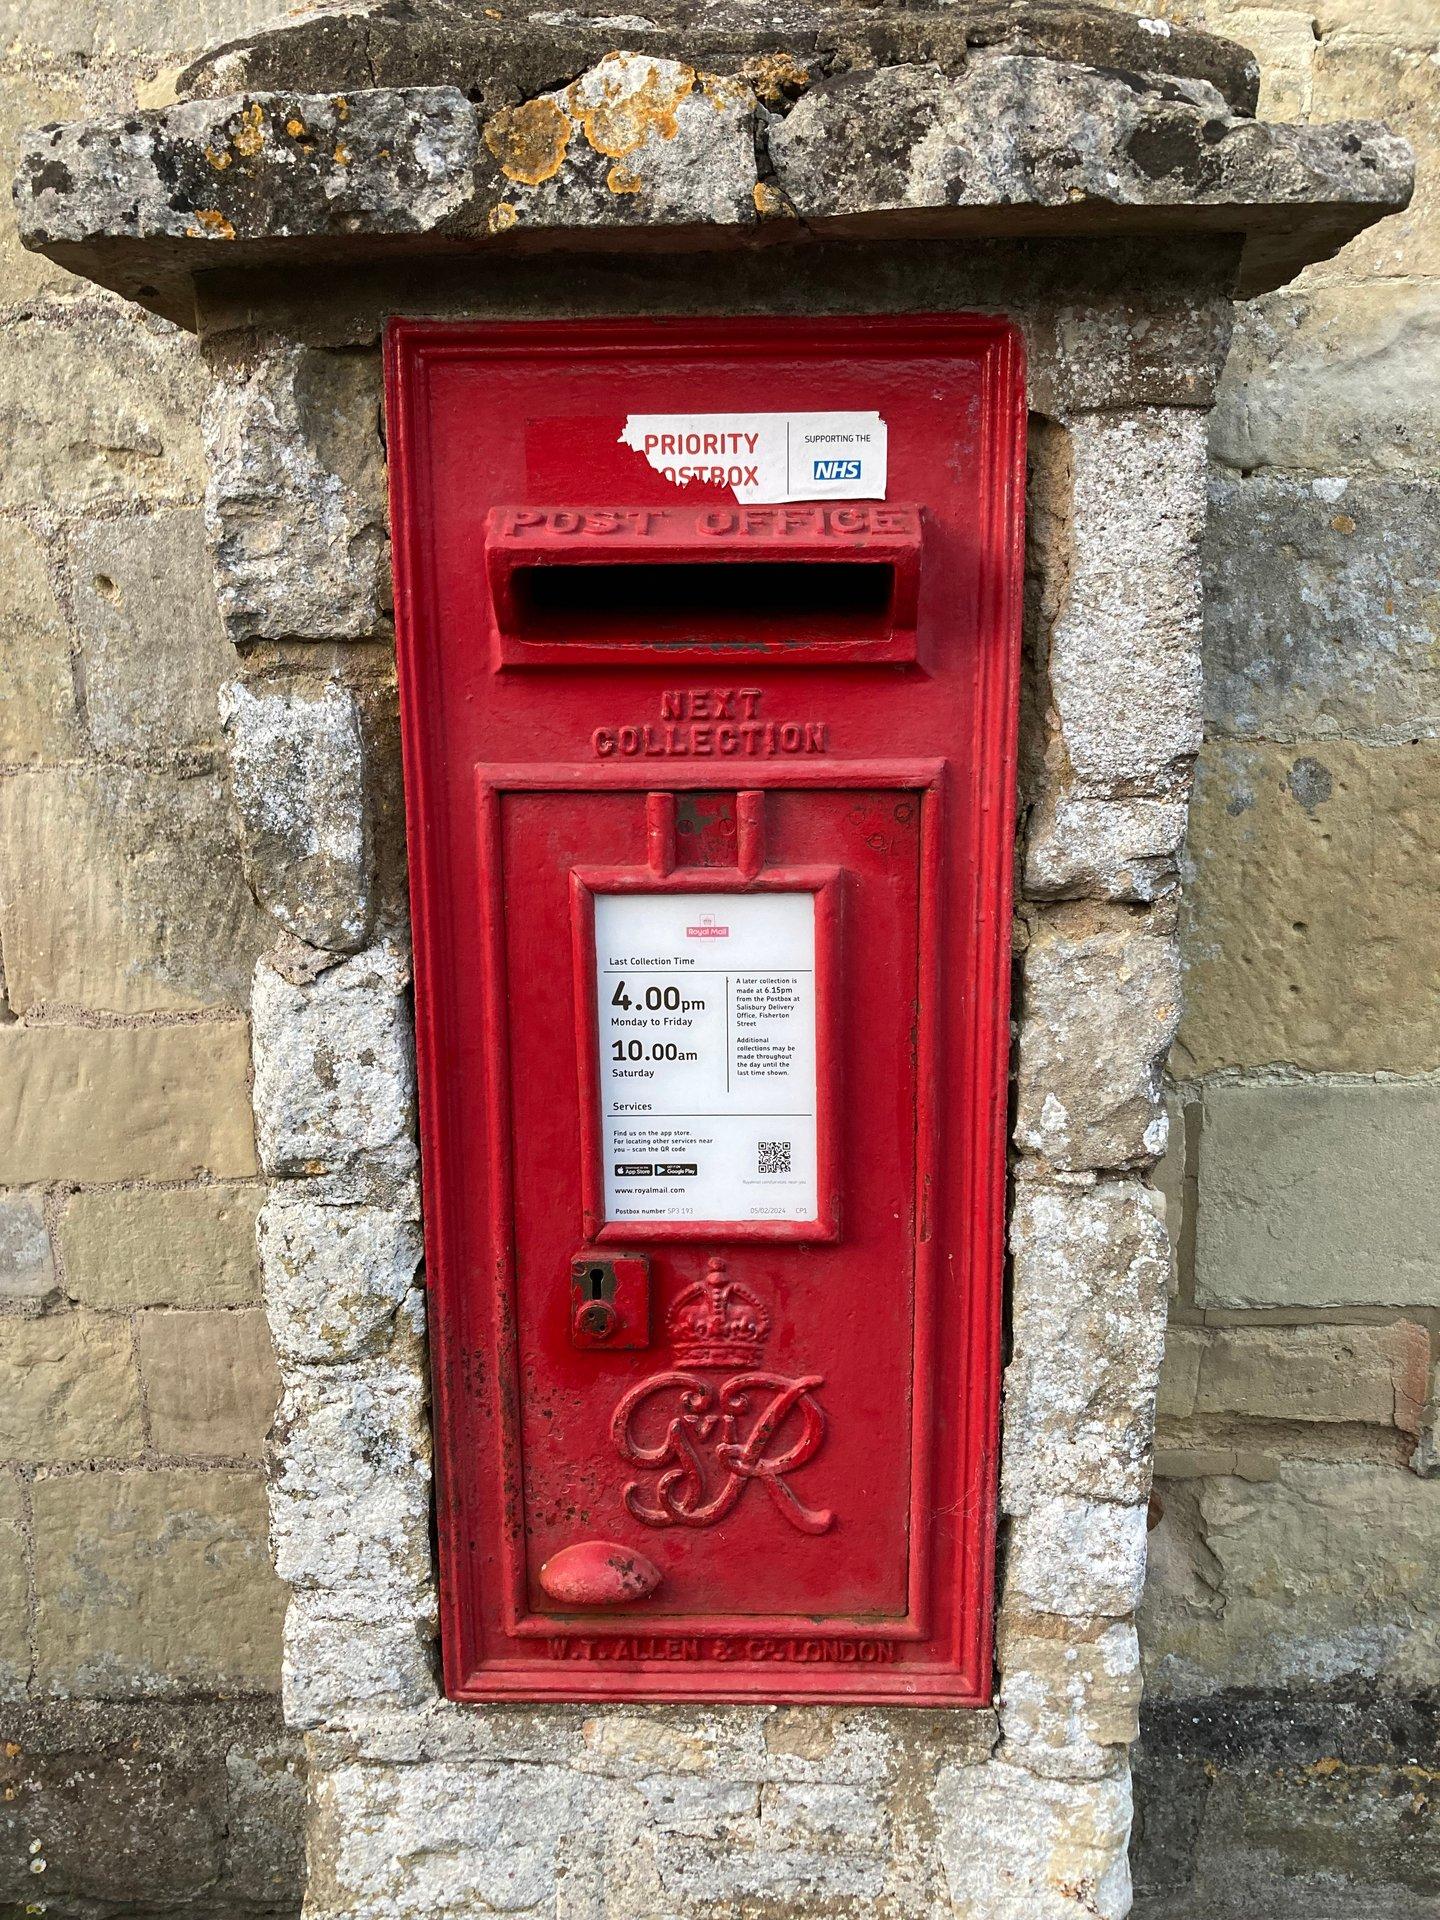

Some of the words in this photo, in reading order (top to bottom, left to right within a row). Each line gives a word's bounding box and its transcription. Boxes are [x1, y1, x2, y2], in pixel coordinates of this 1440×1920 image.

[804, 434, 854, 443] SUPPORTING
[855, 434, 871, 443] THE
[644, 433, 759, 455] PRIORITY
[816, 461, 859, 479] NHS
[504, 510, 667, 537] POST
[698, 508, 907, 536] OFFICE
[660, 689, 763, 720] NEXT
[592, 723, 827, 756] COLLECTION
[688, 928, 709, 936] Royal
[609, 958, 627, 966] Last
[630, 957, 671, 965] Collection
[673, 957, 695, 965] Time
[764, 987, 793, 995] 6.15pm
[612, 980, 705, 1013] 4.00pm
[611, 1018, 648, 1027] Monday
[651, 1018, 660, 1026] to
[663, 1017, 693, 1027] Friday
[612, 1040, 698, 1061] 10.00am
[756, 1053, 792, 1061] throughout
[612, 1069, 655, 1078] Saturday
[613, 1103, 652, 1111] Services
[626, 1138, 651, 1146] locating
[613, 1639, 698, 1660] ALLEN
[712, 1639, 734, 1660] &
[791, 1640, 895, 1662] LONDON
